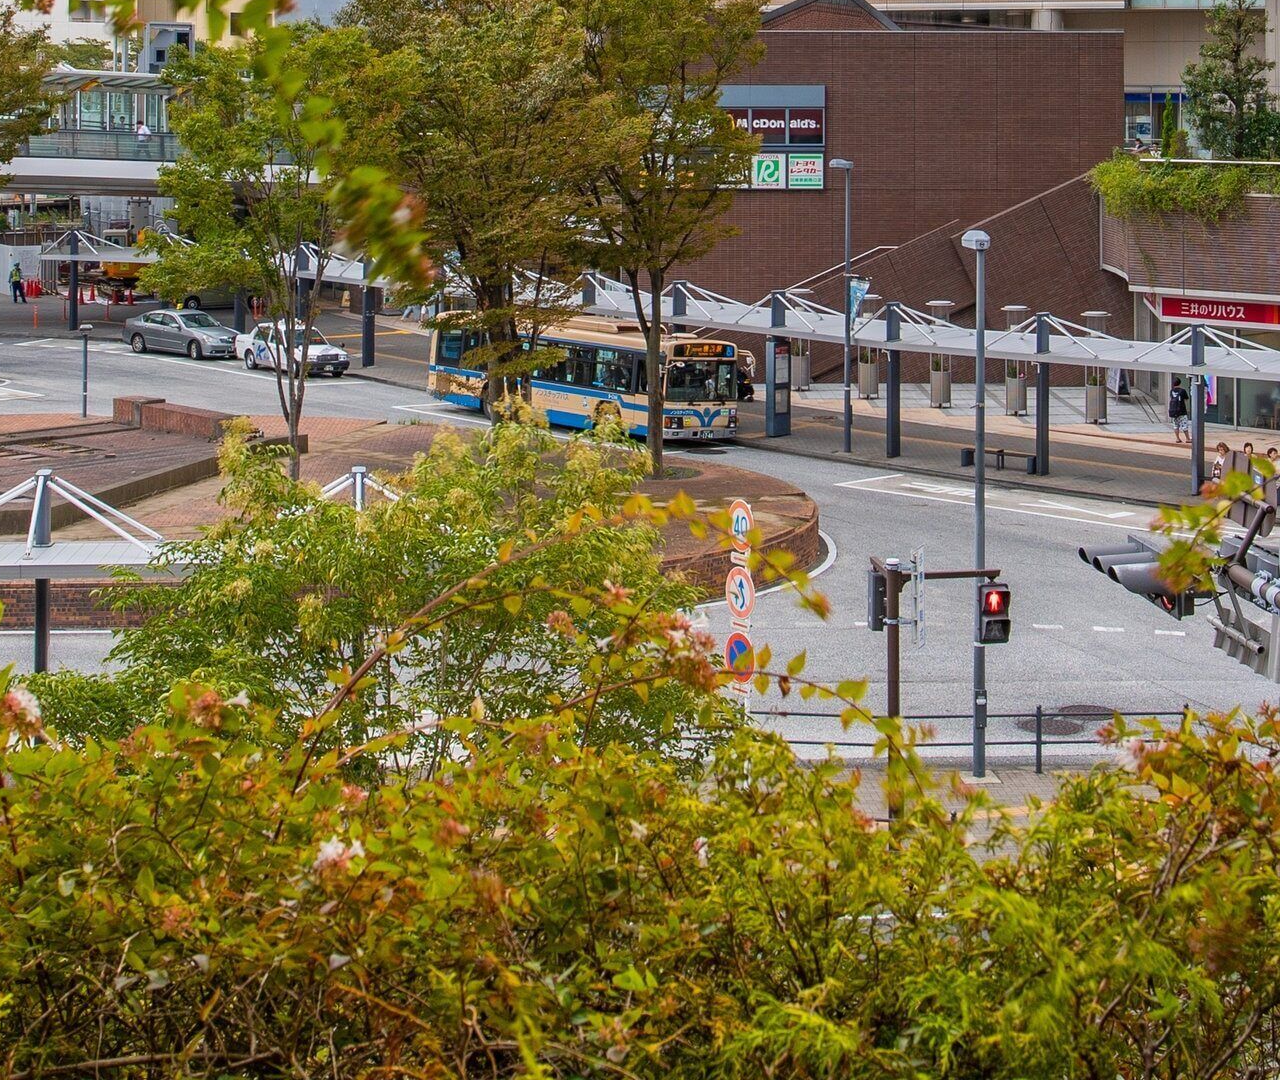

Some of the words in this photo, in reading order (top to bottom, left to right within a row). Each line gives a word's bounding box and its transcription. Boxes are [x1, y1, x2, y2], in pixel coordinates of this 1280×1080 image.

[1180, 302, 1246, 319] 三井のリハウス
[734, 515, 748, 537] 40
